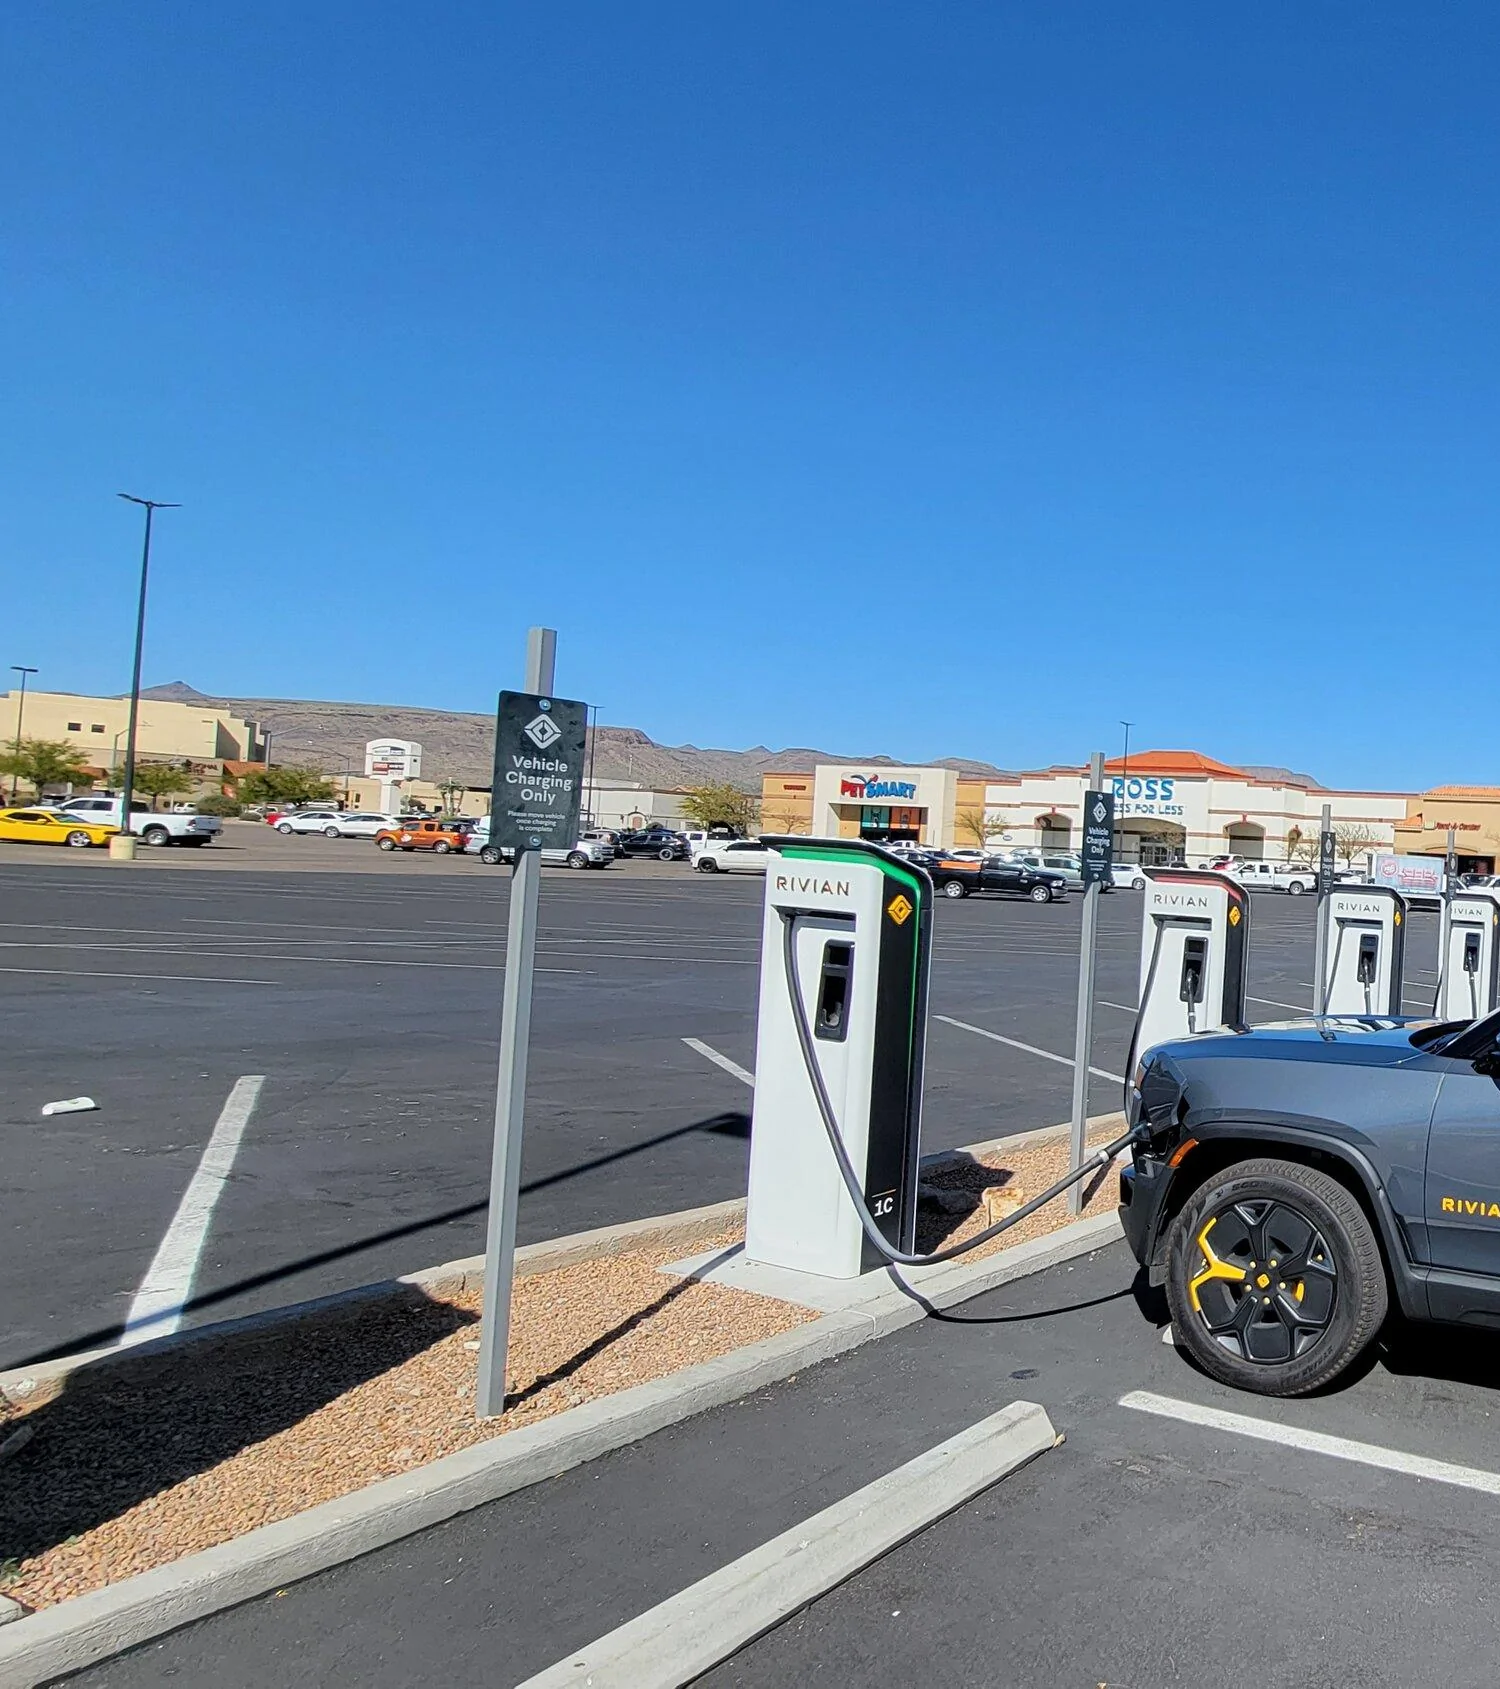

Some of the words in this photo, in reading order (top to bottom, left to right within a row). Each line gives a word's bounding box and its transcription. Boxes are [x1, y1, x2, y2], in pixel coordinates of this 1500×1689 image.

[512, 755, 568, 772] Vehicle
[505, 771, 573, 791] Charging
[1112, 777, 1175, 800] ROSS
[520, 788, 556, 805] Only
[1135, 804, 1155, 813] FOR
[1158, 805, 1184, 815] LESS
[532, 818, 557, 827] charging
[525, 825, 553, 833] complete
[1088, 827, 1109, 836] Vehicle
[1086, 836, 1110, 847] Charging
[1091, 846, 1104, 855] Only
[776, 876, 850, 896] RIVIAN
[1153, 894, 1208, 907] RIVIAN
[1337, 902, 1380, 912] RIVIAN
[1451, 907, 1483, 916] IVIAN
[874, 1197, 893, 1217] 1C
